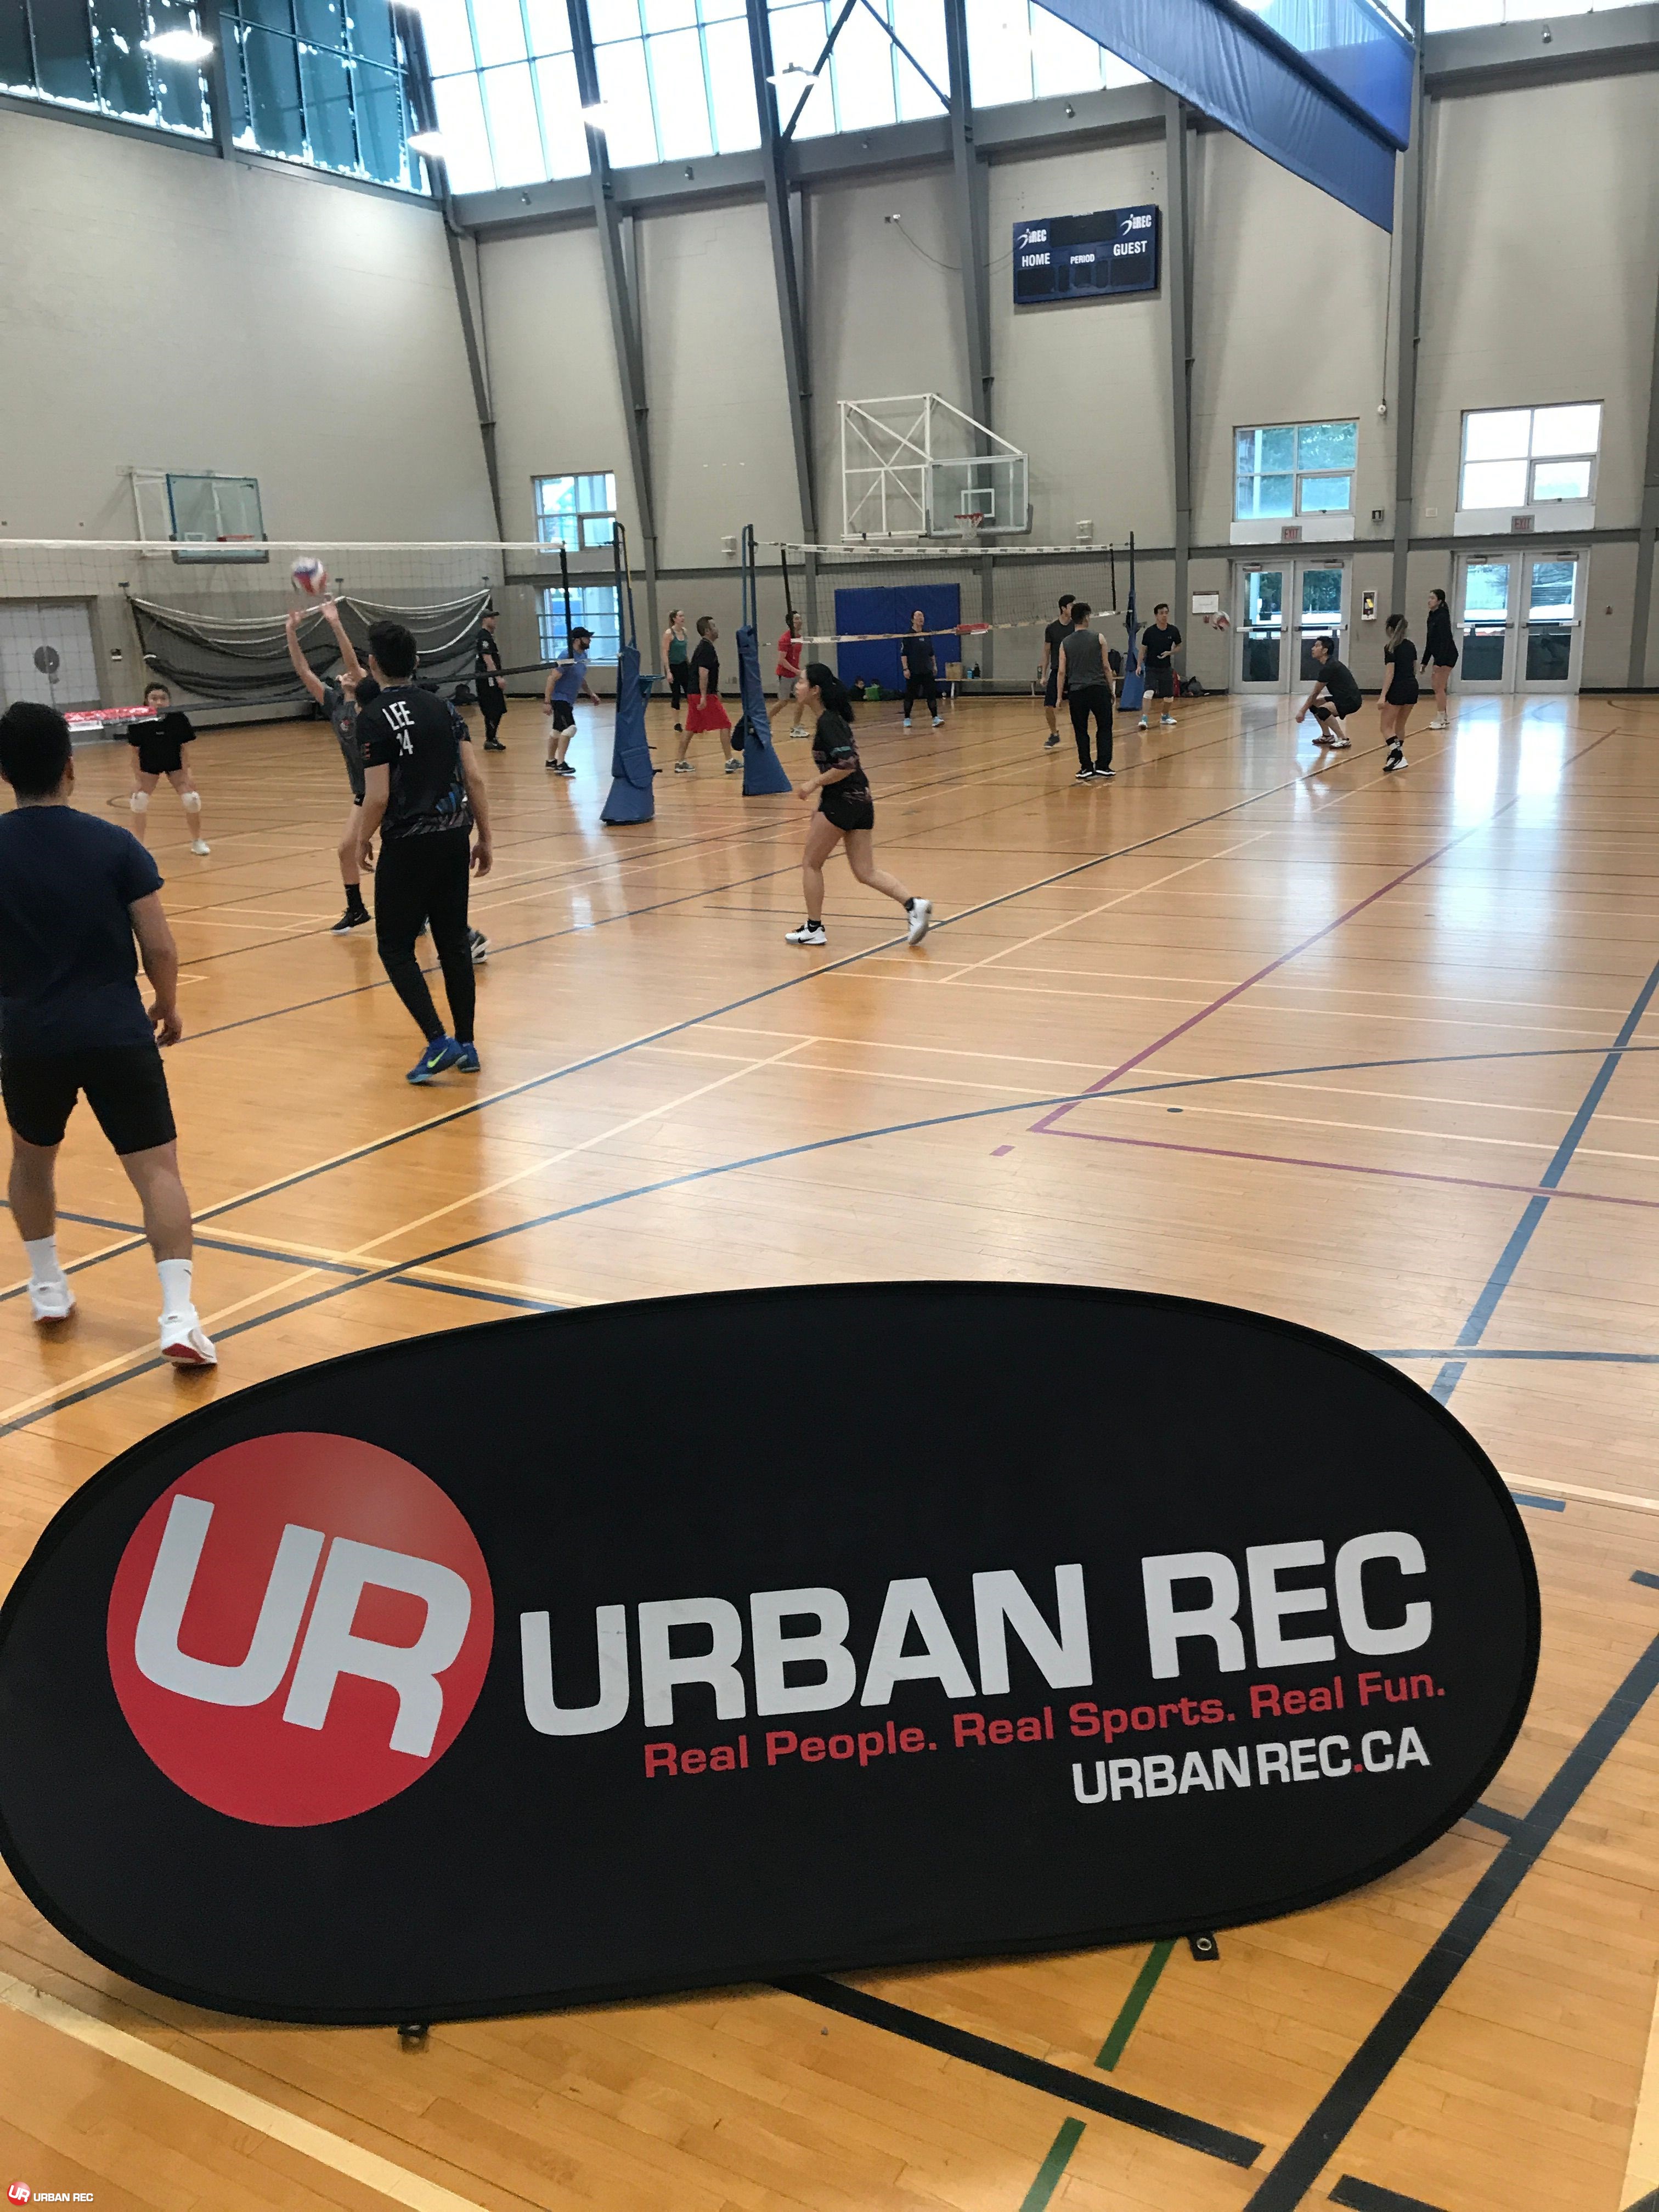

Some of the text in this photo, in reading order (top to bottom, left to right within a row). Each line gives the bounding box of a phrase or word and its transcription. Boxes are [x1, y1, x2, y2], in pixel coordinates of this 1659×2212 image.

[1022, 252, 1051, 267] HOME
[1070, 253, 1095, 264] PERIOD
[1113, 240, 1148, 256] GUEST
[1284, 528, 1299, 540] EXIT
[1514, 517, 1531, 529] EXIT
[382, 701, 415, 731] LEE
[134, 1494, 472, 1758] UR
[520, 1531, 1432, 1736] URBAN REC
[645, 1672, 1444, 1778] Real People. Real Sports. Real Fun.
[1071, 1726, 1430, 1804] URBANREC.CA
